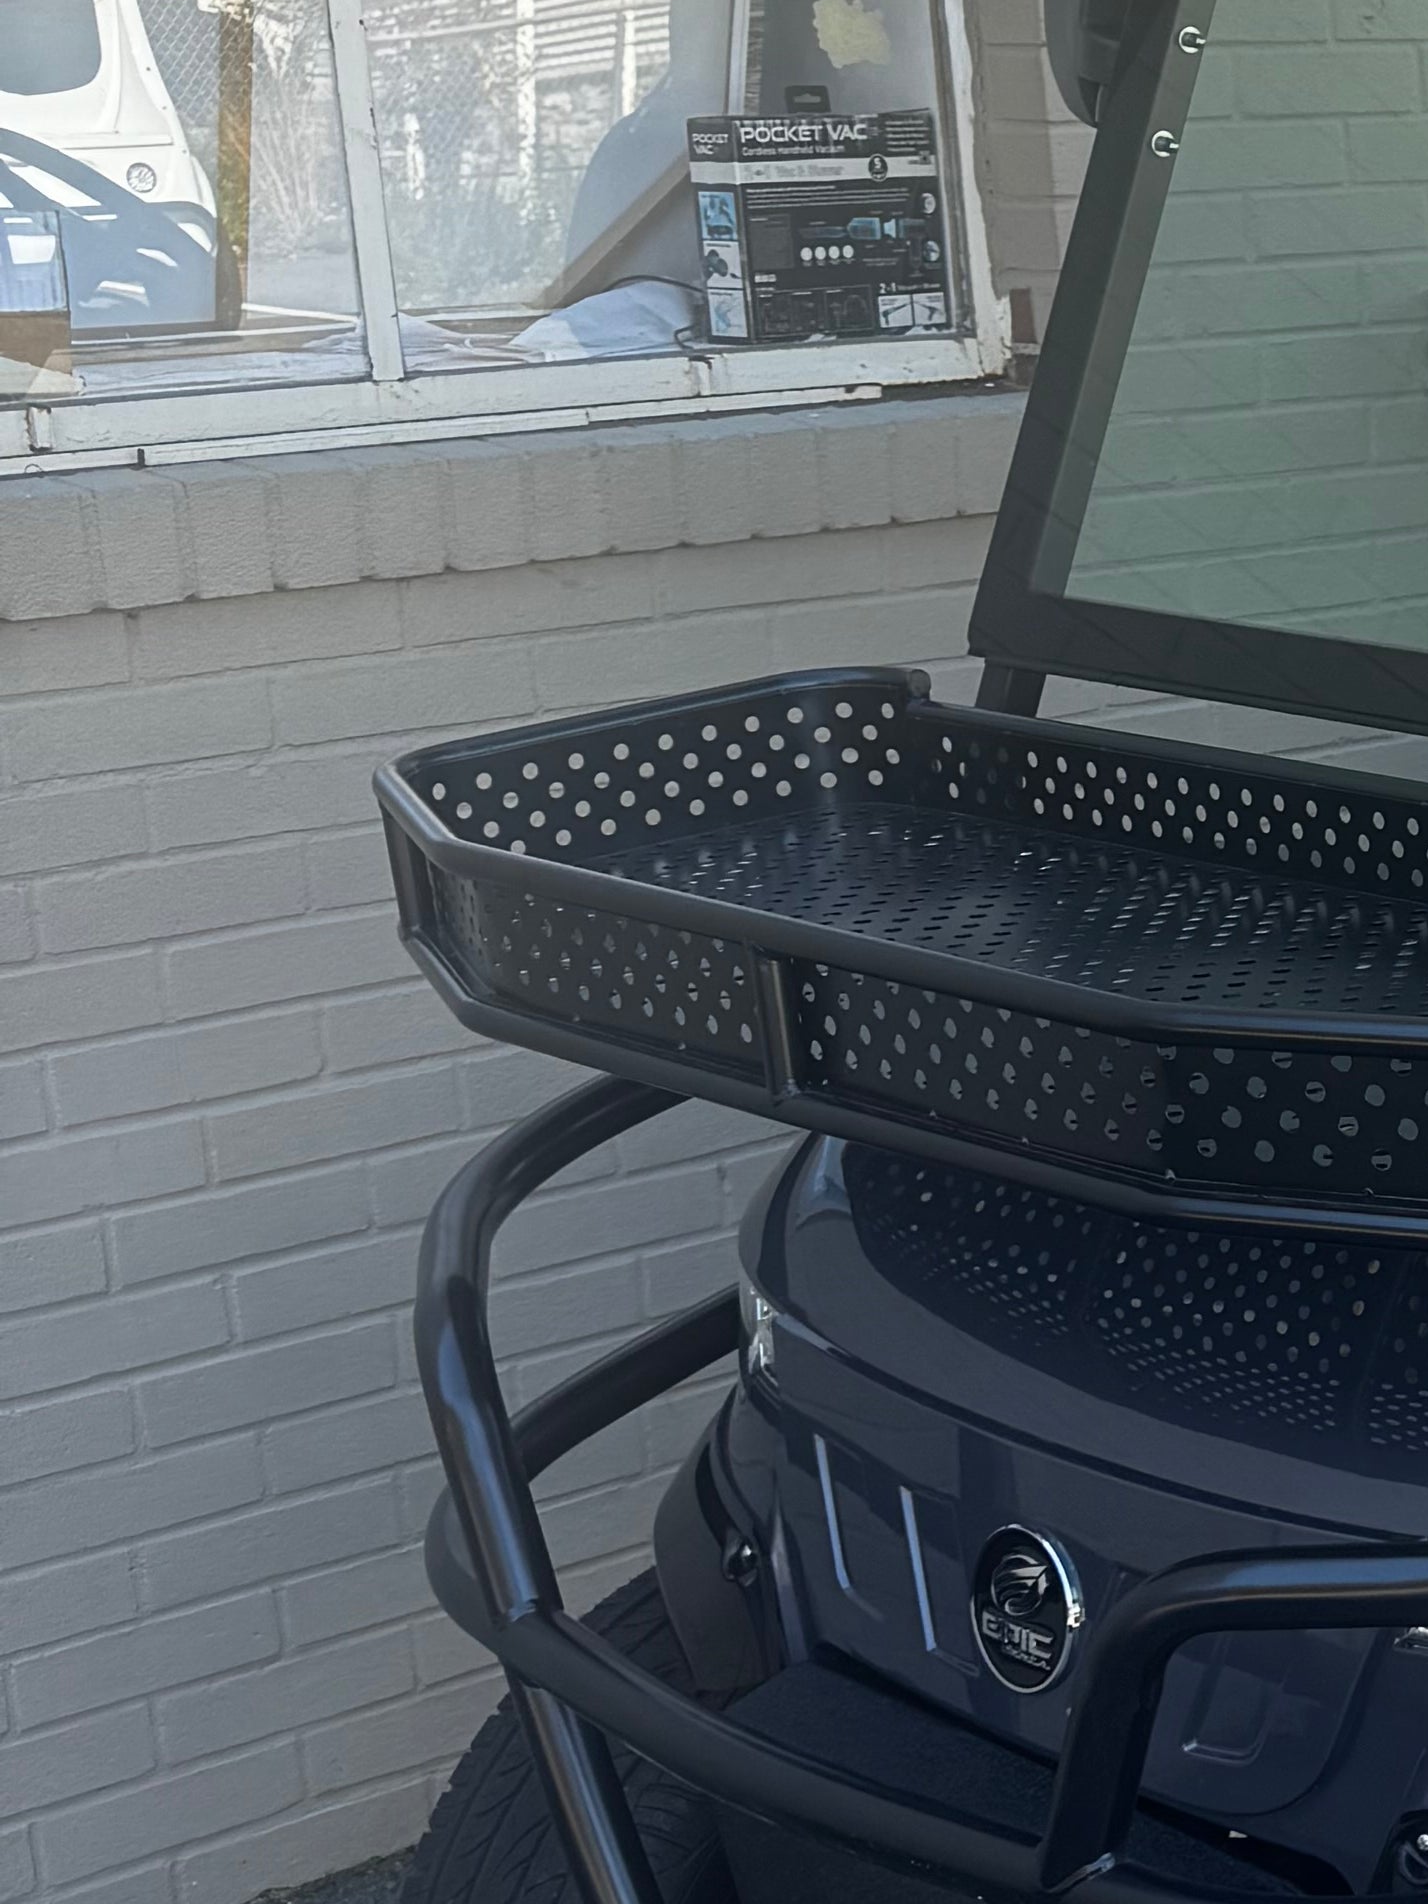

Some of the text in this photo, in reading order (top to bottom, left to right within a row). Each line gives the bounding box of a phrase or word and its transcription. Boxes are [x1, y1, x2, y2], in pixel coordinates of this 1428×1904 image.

[692, 133, 728, 144] POCKET
[739, 125, 823, 143] POCKET
[826, 123, 868, 141] VAC
[693, 145, 714, 155] VAC
